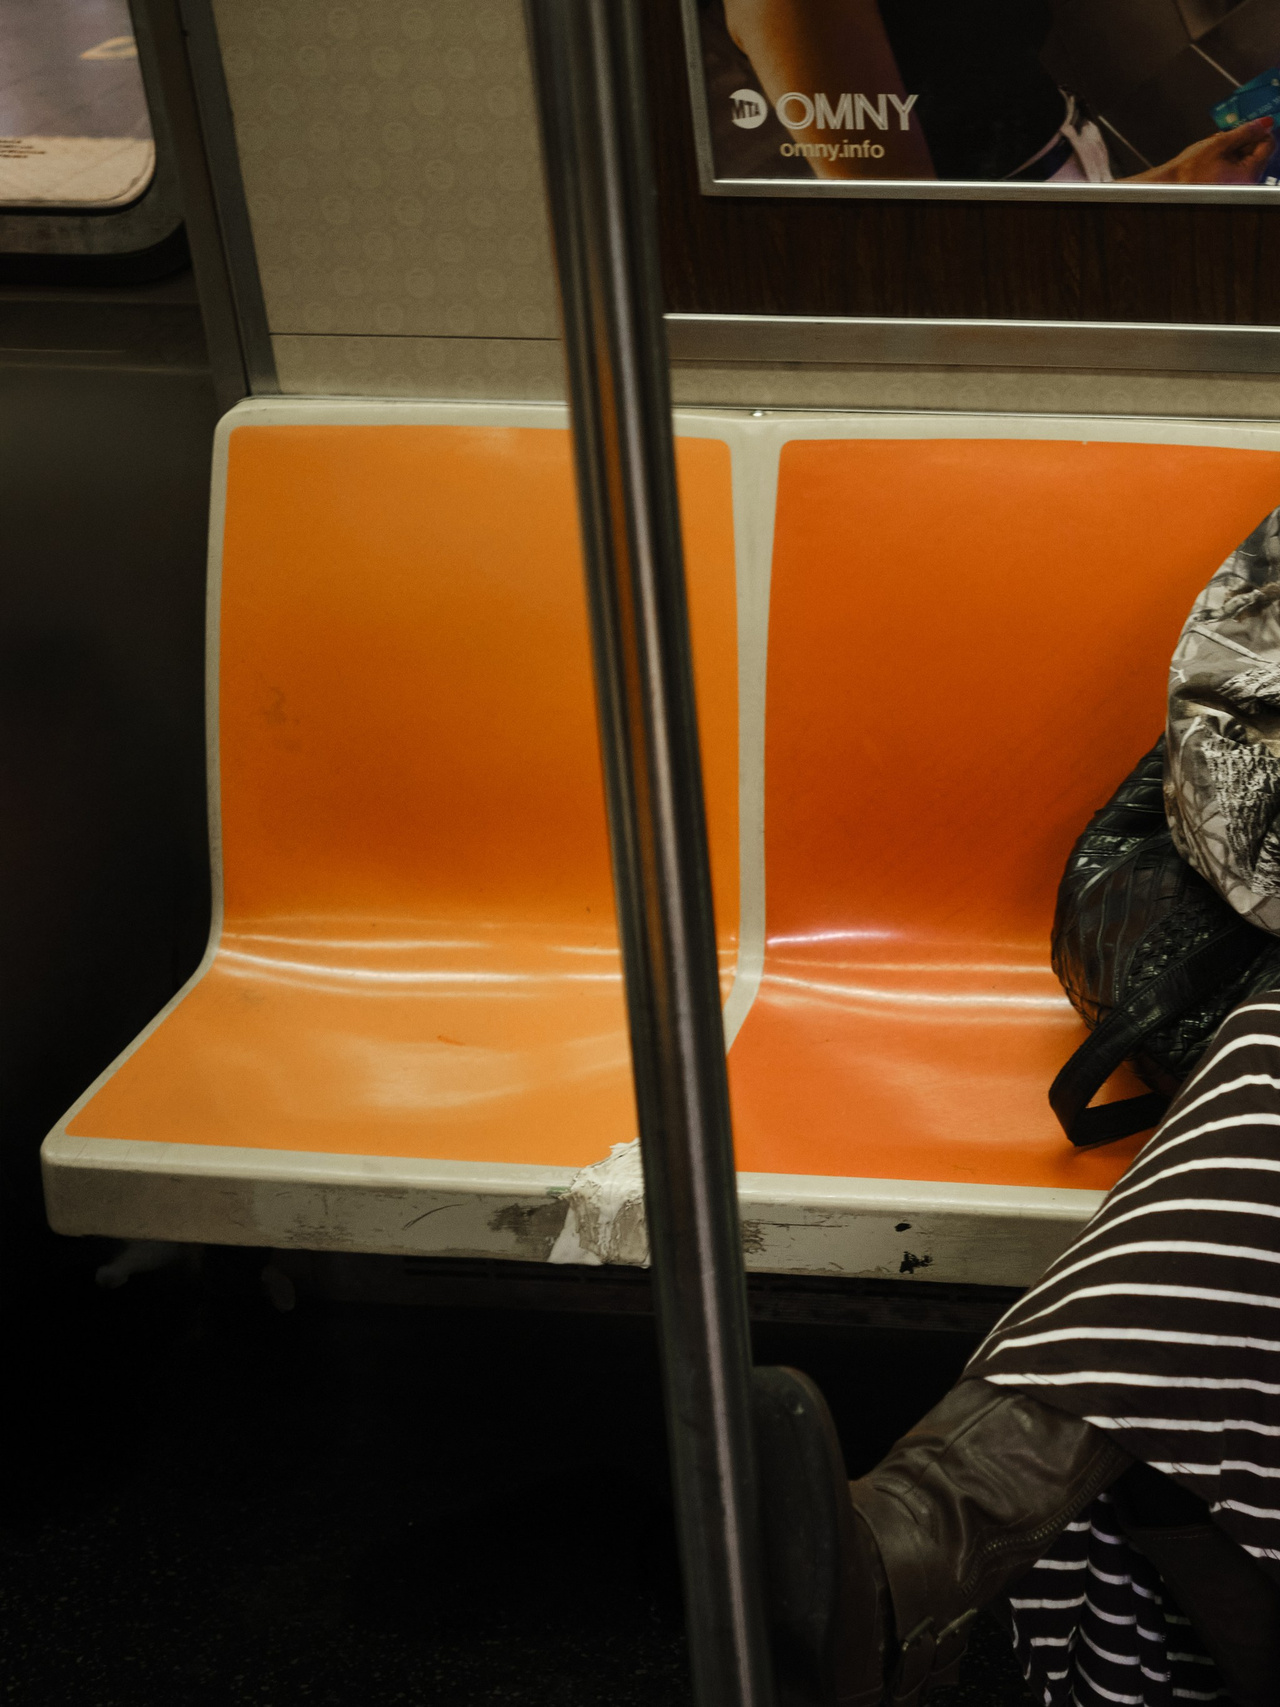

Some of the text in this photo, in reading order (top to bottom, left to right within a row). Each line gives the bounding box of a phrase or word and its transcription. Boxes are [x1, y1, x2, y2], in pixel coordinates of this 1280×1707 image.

[731, 99, 762, 120] MTA
[776, 91, 919, 131] OMNY
[780, 139, 885, 161] omny.info
